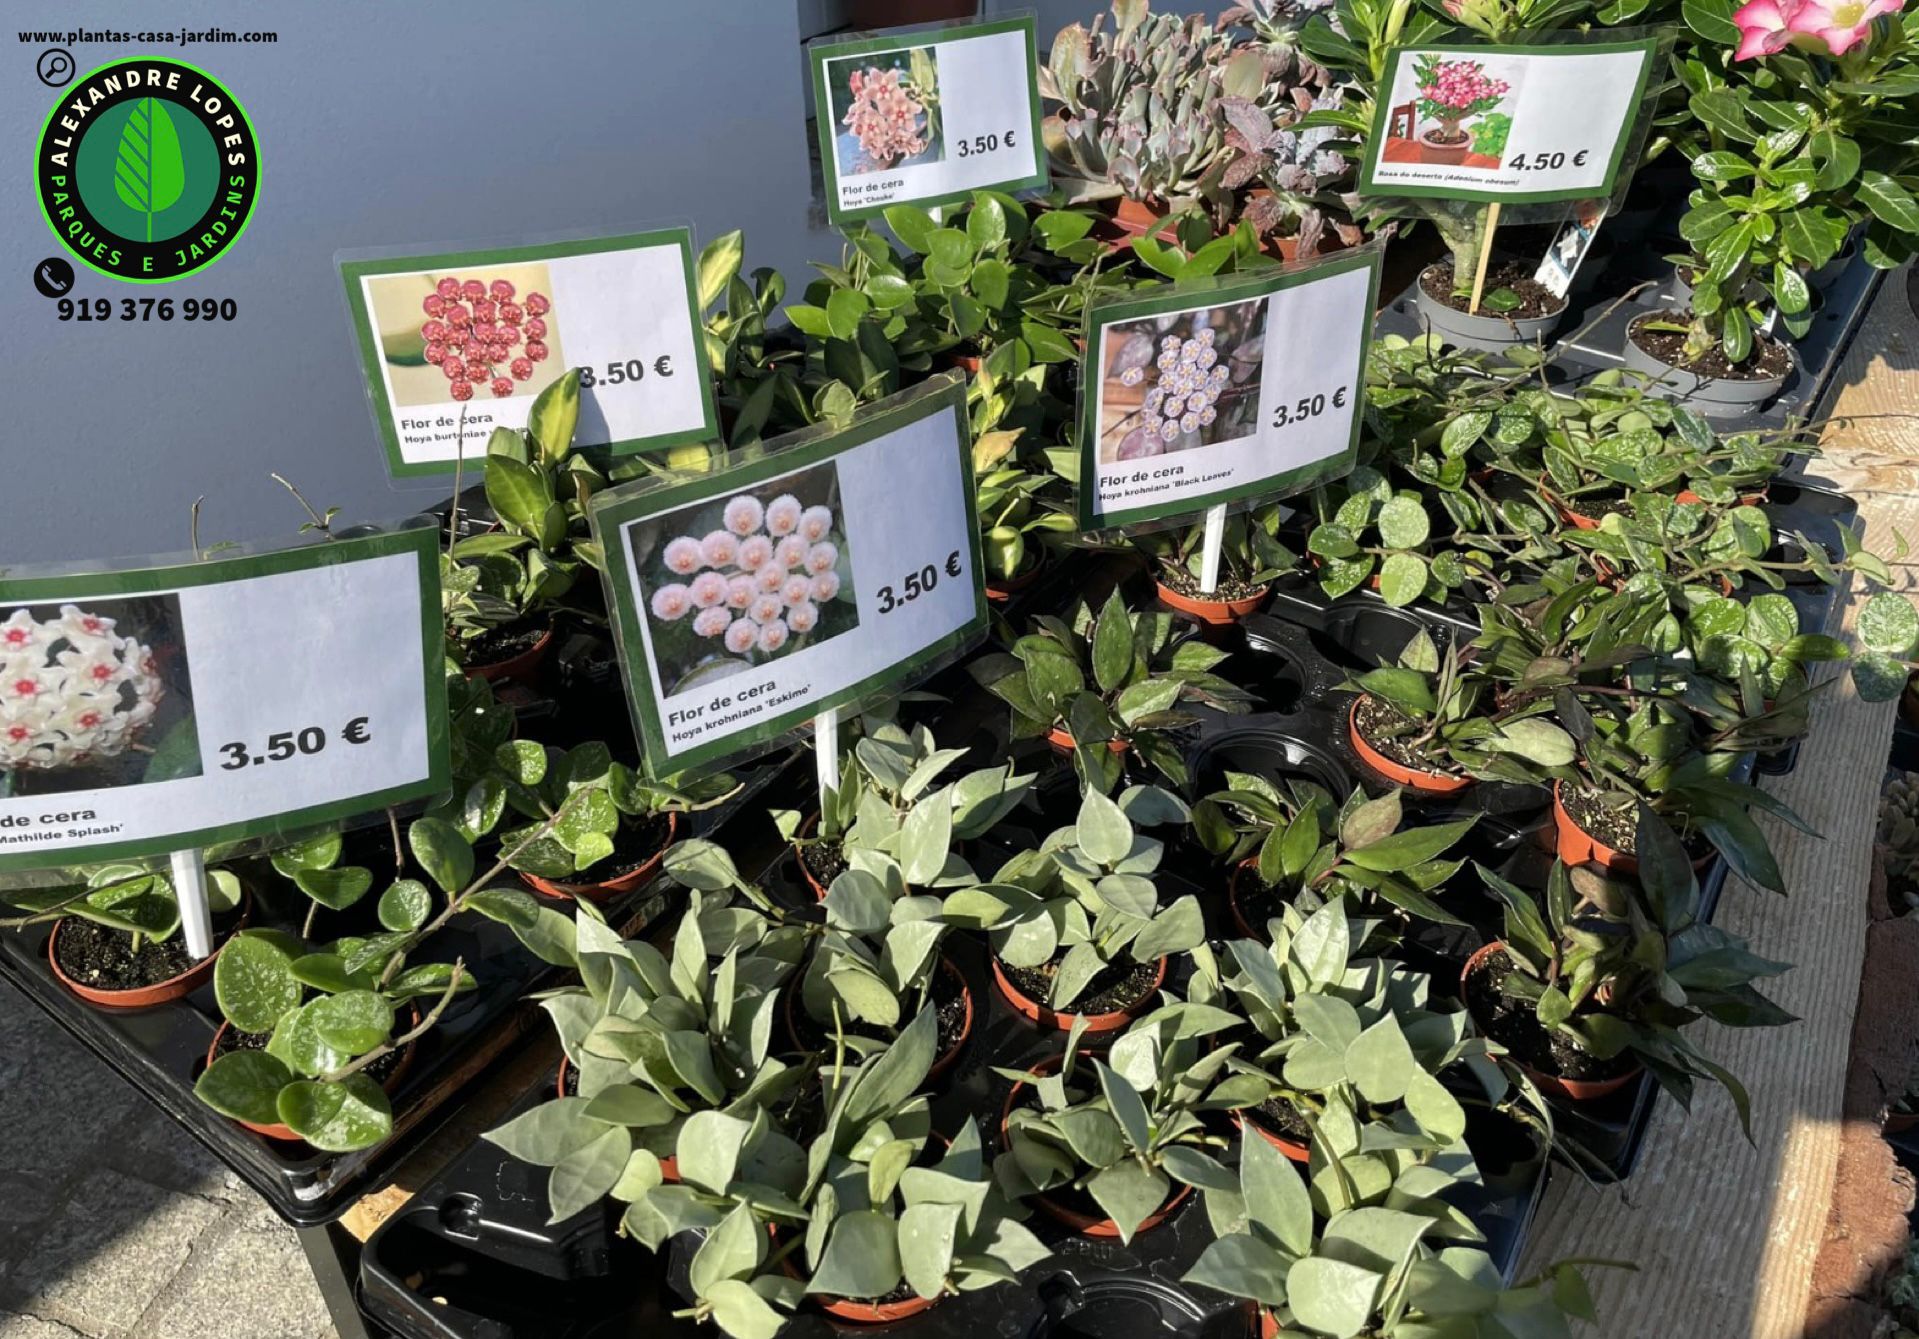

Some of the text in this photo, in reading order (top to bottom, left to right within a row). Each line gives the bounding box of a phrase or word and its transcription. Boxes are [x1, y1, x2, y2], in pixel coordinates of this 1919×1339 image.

[958, 131, 1015, 157] 3.50 €
[1509, 149, 1589, 171] 4.50 €
[1411, 171, 1443, 179] deserto
[842, 179, 904, 195] Flor de cera
[579, 355, 674, 388] 3.50 €
[1272, 386, 1347, 427] 3.50 €
[401, 414, 494, 430] Flor de cera
[404, 435, 432, 444] Hoya
[1100, 465, 1184, 488] Flor de cera
[1099, 491, 1122, 501] Hoya
[1124, 484, 1170, 497] krohniana
[1172, 478, 1200, 488] 'Black
[877, 550, 962, 614] 3.50 €
[668, 680, 776, 727] Flor de cera
[672, 684, 811, 743] Hoya krohniana 'Eskimo'
[219, 716, 371, 771] 3.50 €
[0, 810, 96, 828] de cera
[67, 823, 124, 838] Splash'
